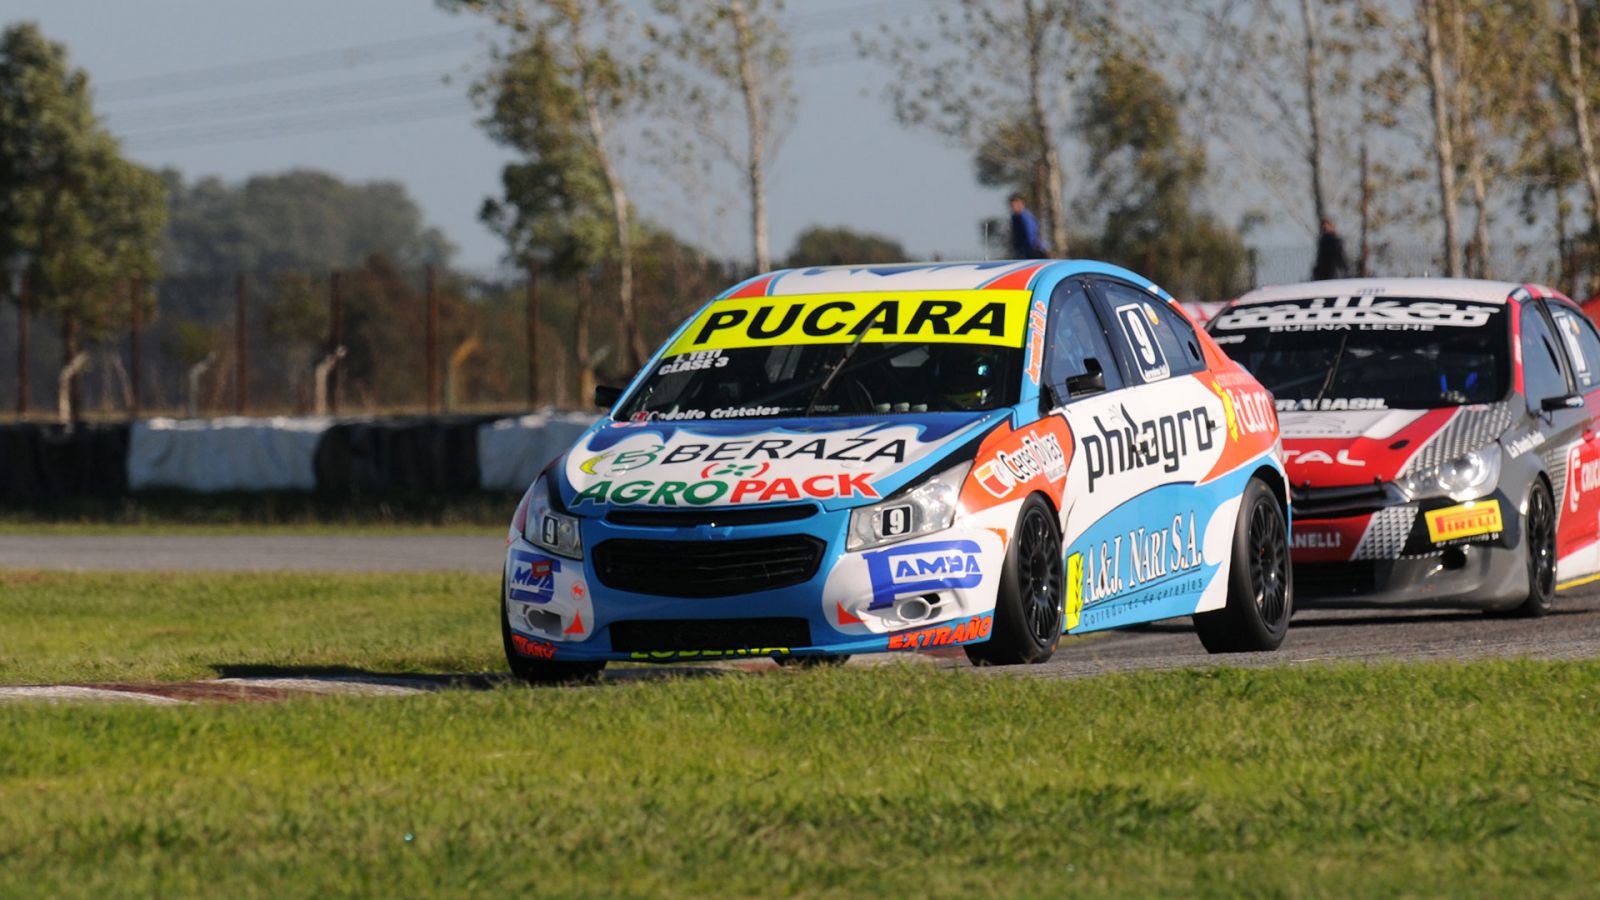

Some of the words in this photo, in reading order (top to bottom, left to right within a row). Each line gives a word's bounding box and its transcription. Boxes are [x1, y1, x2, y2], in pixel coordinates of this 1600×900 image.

[692, 299, 1006, 346] PUCARA
[1359, 323, 1434, 332] LECHE
[1127, 310, 1156, 365] 9
[658, 357, 715, 376] CLASE
[715, 356, 730, 369] 3
[709, 405, 781, 419] Cristales
[660, 438, 907, 464] BERAZA
[546, 517, 555, 544] 9
[889, 508, 905, 534] 9
[1435, 507, 1497, 535] PIRELLI
[1170, 510, 1204, 572] S.A.
[1290, 532, 1341, 548] NELLI
[888, 615, 994, 649] EXTRAÑO
